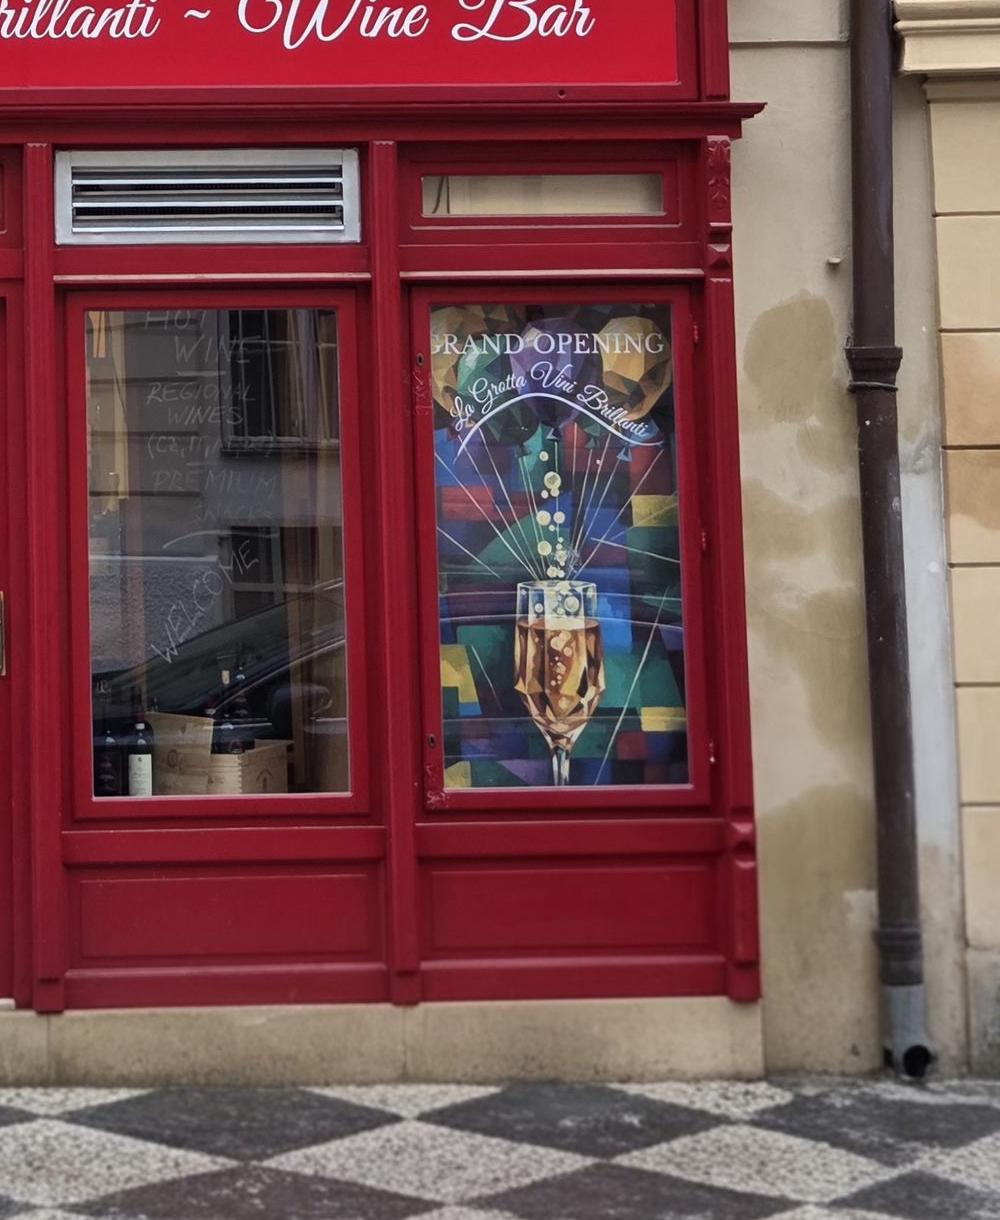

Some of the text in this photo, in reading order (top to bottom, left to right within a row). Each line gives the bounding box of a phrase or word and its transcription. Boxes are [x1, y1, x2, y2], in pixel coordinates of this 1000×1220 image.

[174, 333, 262, 364] WINE
[533, 332, 664, 355] OPENING
[146, 381, 257, 405] REGIONAL
[449, 395, 475, 432] La
[467, 372, 528, 415] Grotta
[530, 360, 578, 394] Vini
[576, 383, 650, 438] Brillanti
[167, 405, 244, 427] WINES
[150, 539, 261, 665] WELCOME
